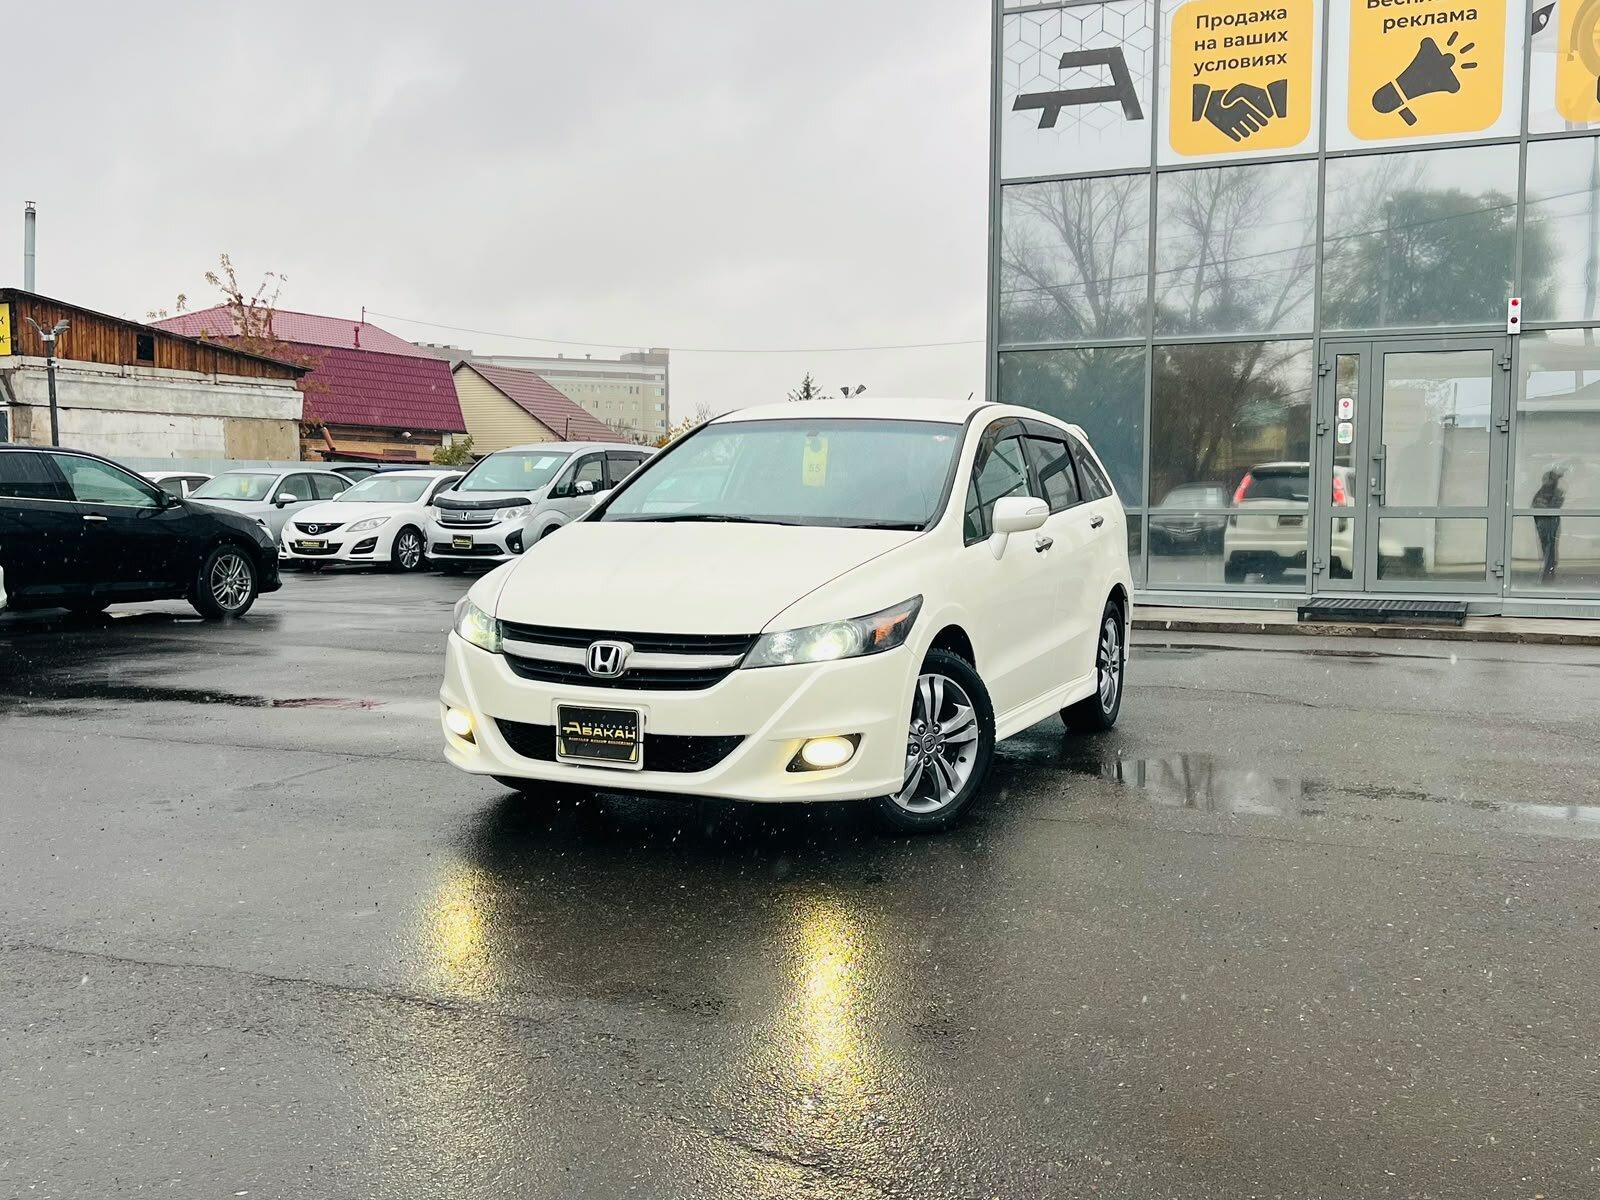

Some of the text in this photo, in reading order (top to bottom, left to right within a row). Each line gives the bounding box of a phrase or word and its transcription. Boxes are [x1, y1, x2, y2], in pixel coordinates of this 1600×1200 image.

[1196, 8, 1287, 30] Продажа
[1383, 8, 1478, 33] реклама
[1194, 31, 1288, 51] на ваших
[1193, 53, 1288, 77] условиях
